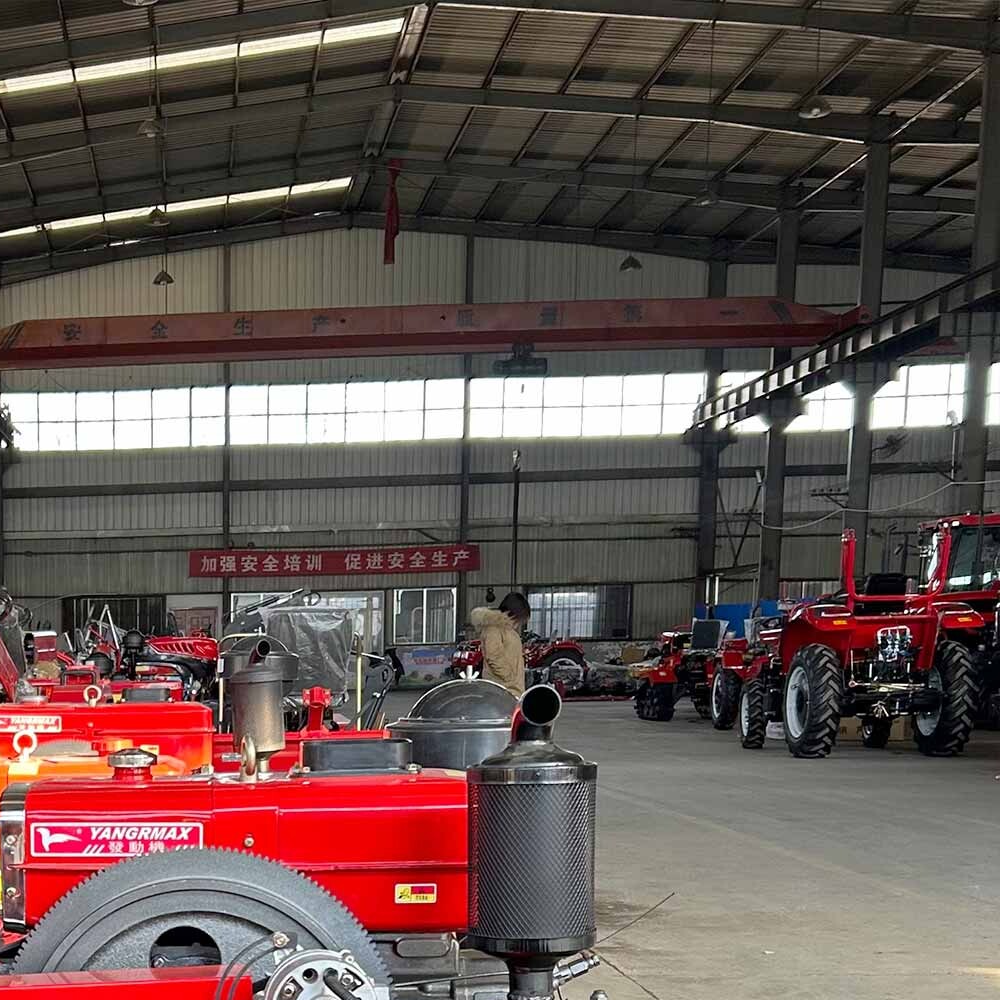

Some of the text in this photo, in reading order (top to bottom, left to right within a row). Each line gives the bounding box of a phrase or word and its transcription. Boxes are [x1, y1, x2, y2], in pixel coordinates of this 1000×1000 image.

[200, 550, 470, 572] 加强安全培训 促进安全生产
[89, 827, 193, 840] YANGRMAX
